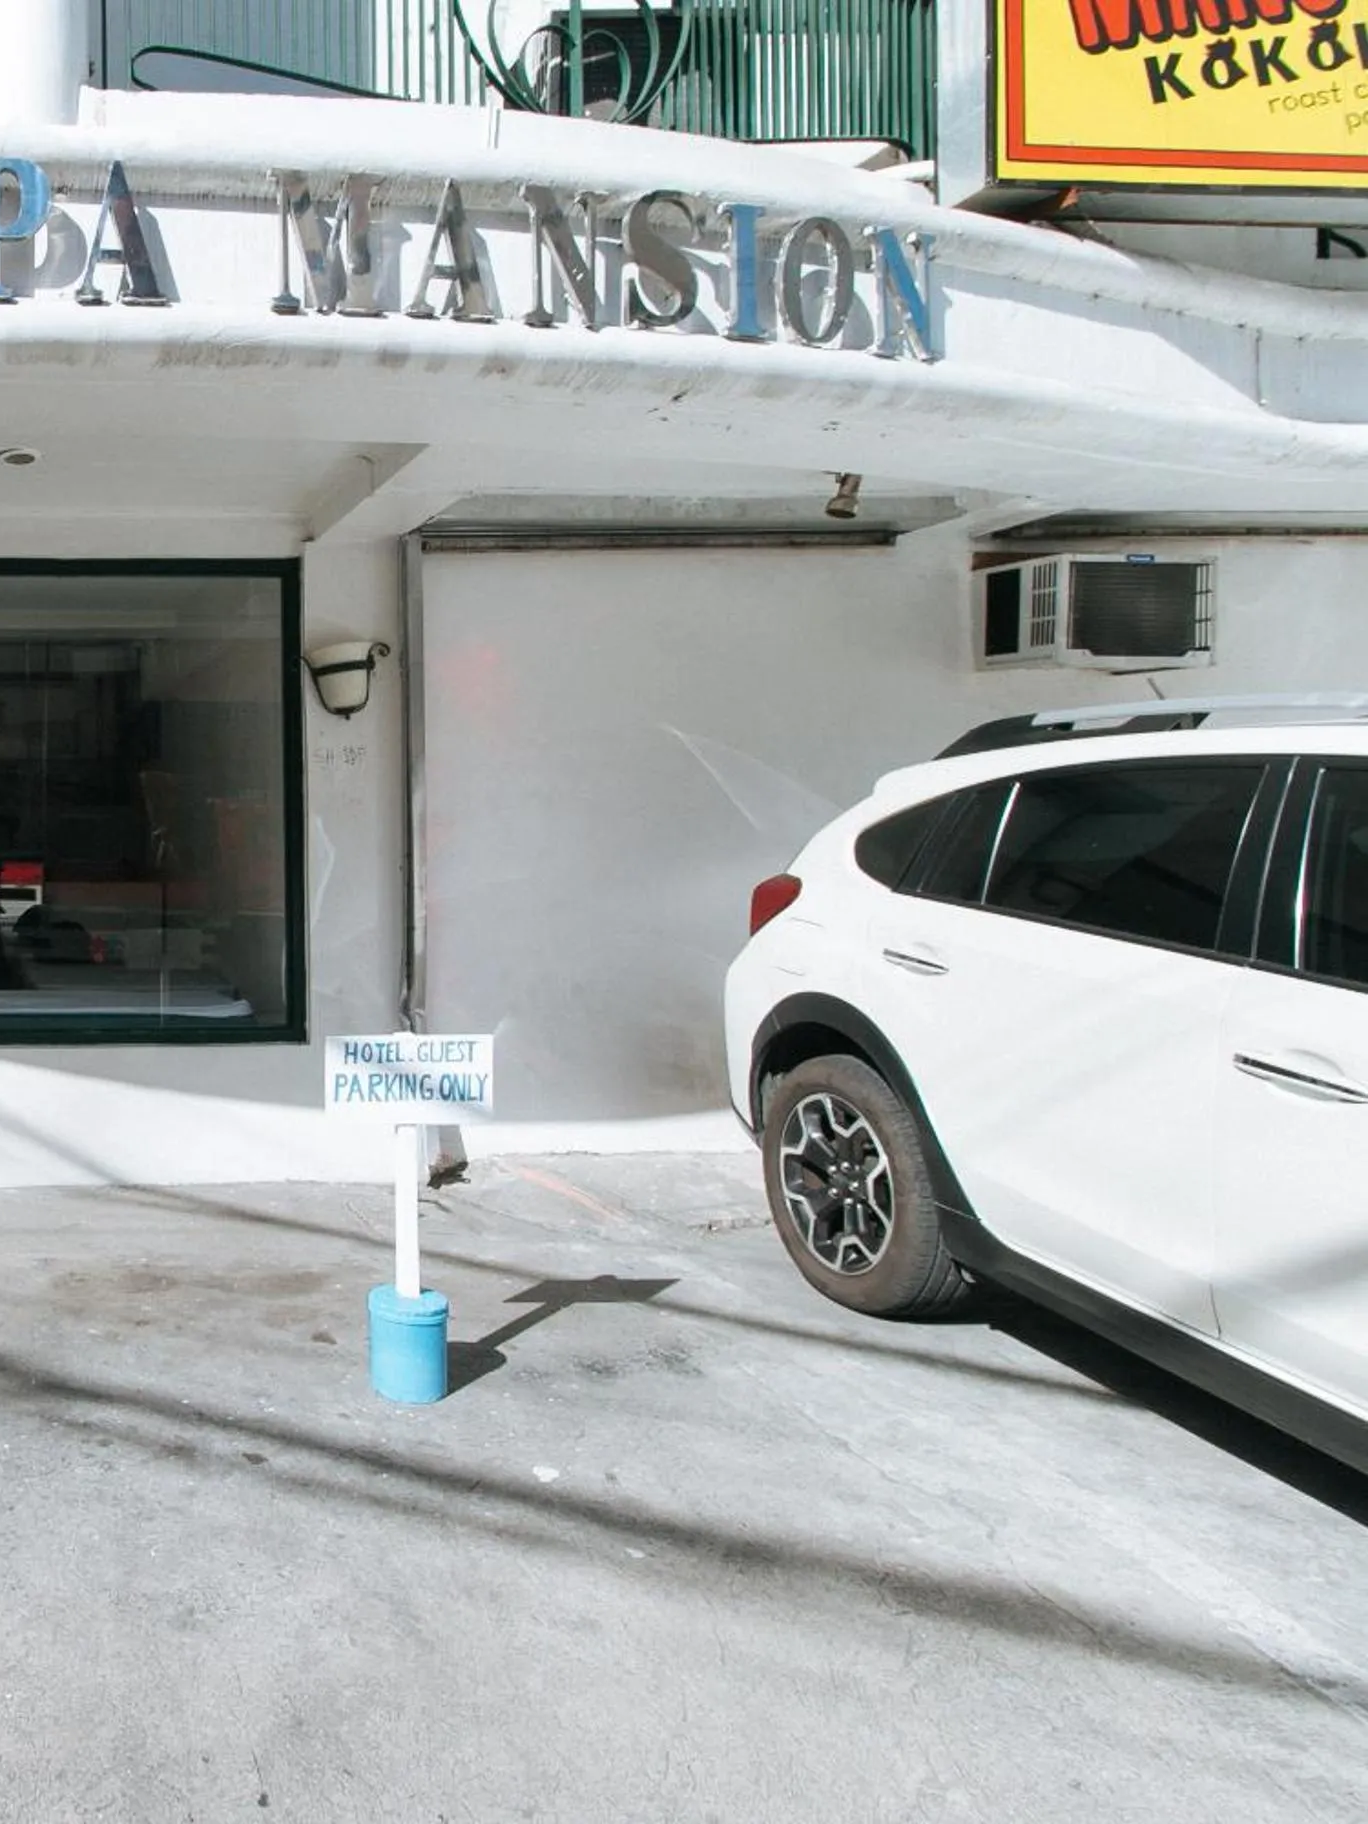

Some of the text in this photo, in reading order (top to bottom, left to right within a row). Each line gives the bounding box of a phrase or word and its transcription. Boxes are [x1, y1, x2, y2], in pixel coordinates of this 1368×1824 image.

[1268, 81, 1343, 113] roast
[265, 168, 936, 361] MANSION
[417, 1040, 477, 1063] GUEST
[439, 1073, 488, 1102] ONLY
